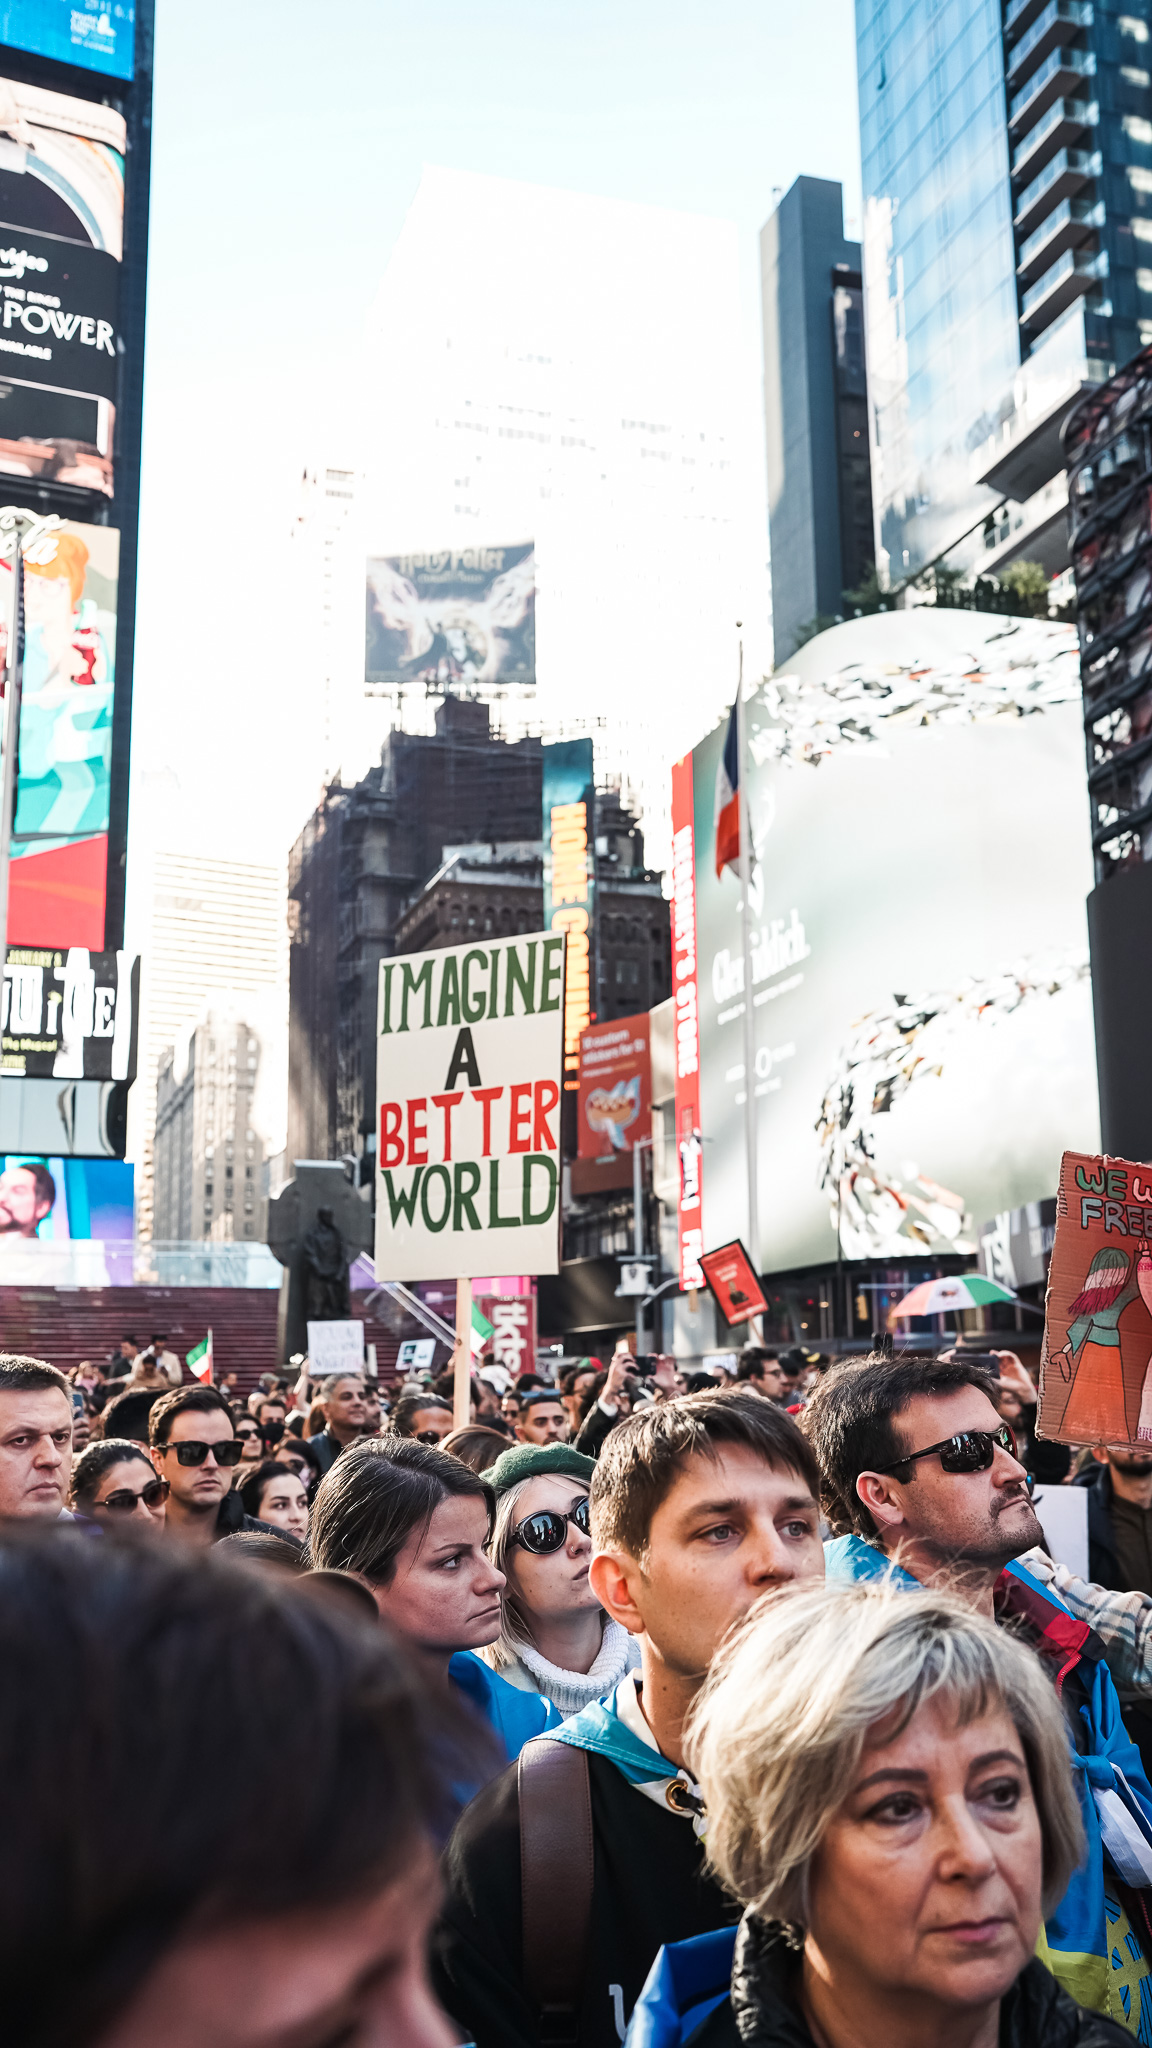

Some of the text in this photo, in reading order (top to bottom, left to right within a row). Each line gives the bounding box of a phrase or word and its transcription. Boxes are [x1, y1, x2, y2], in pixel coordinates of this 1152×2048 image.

[3, 300, 116, 357] POWER
[551, 802, 588, 906] HOME
[381, 937, 563, 1036] IMAGINE
[444, 1027, 482, 1091] A
[674, 981, 698, 1078] STORE
[380, 1080, 559, 1168] BETTER
[381, 1154, 559, 1233] WORLD
[1075, 1165, 1128, 1201] WE
[492, 1302, 528, 1373] tkts
